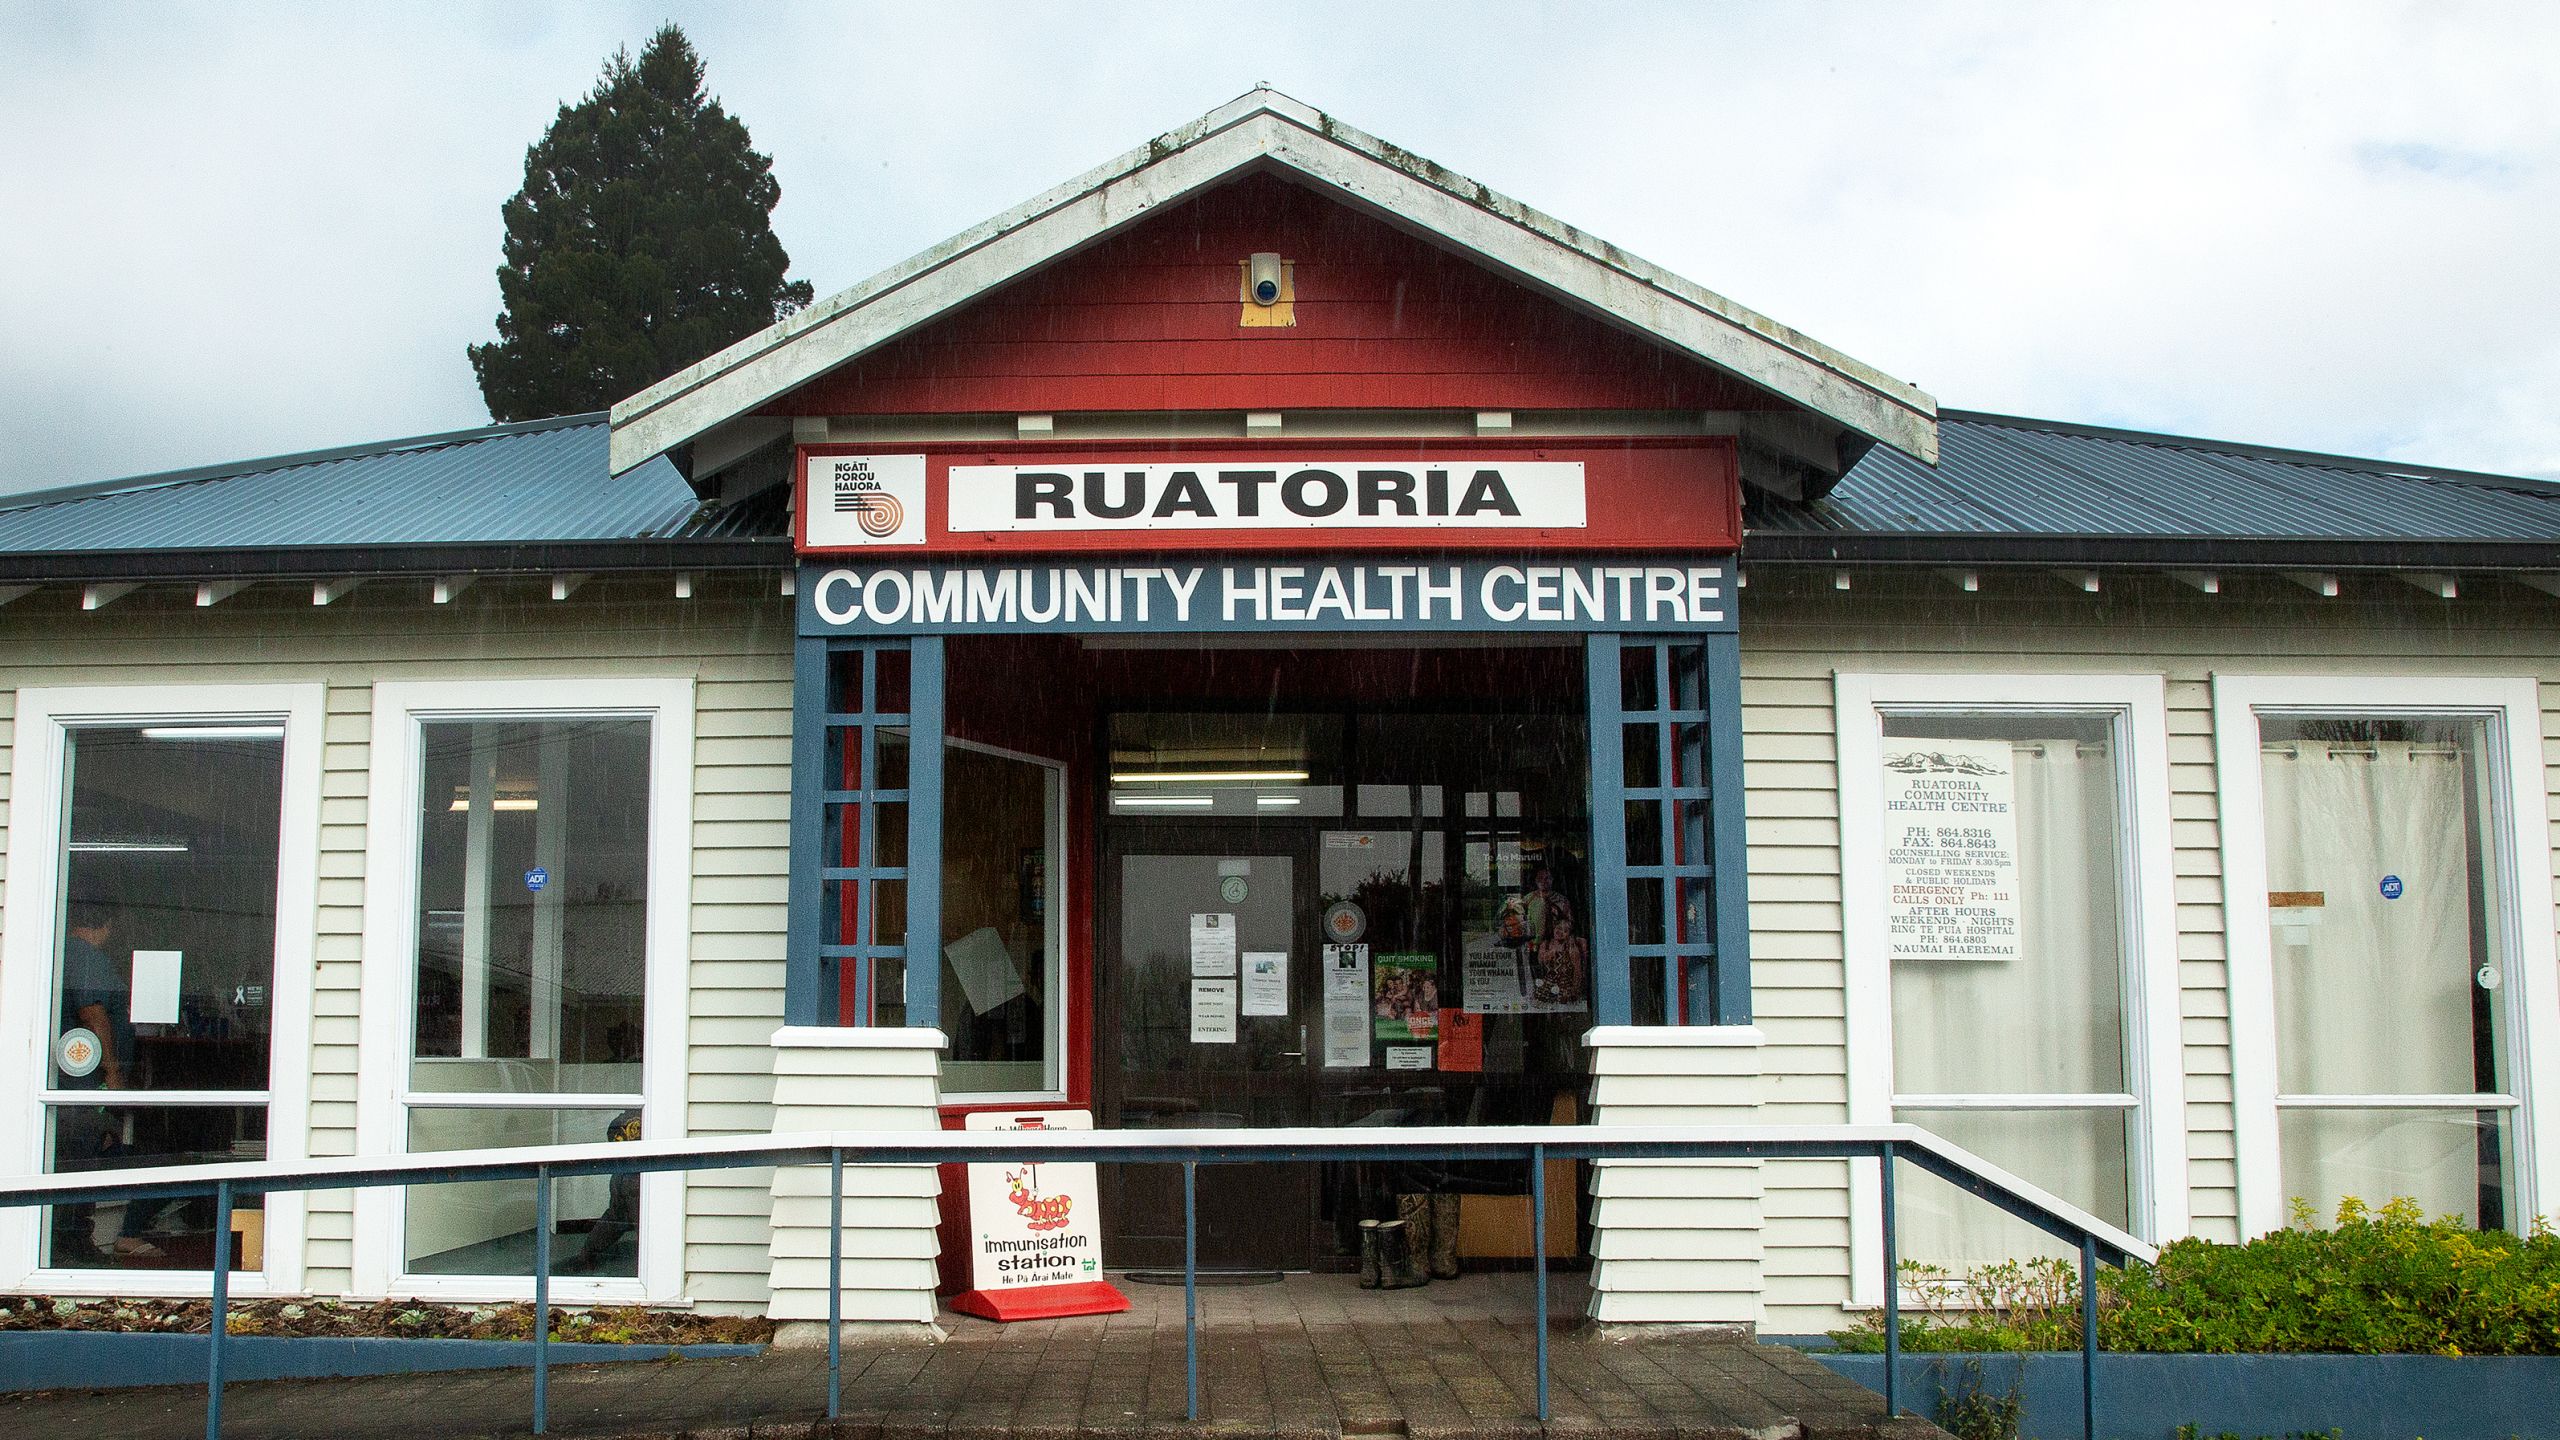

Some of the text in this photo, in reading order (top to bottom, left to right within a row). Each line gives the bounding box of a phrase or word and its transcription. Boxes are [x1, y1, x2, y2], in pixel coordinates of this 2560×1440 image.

[835, 461, 867, 472] NGĀTI
[835, 472, 874, 481] POROU
[835, 482, 881, 491] HAUORA
[1015, 469, 1521, 519] RUATORIA
[814, 566, 1723, 625] COMMUNITY HEALTH CENTRE
[1912, 779, 1981, 790] RUATORIA
[1904, 790, 1989, 801] COMMUNITY
[1887, 800, 2008, 813] HEALTH CENTRE
[1907, 827, 1992, 838] PH: 864.8316
[1903, 837, 1996, 849] FAX: 864.8643
[1889, 848, 1961, 857] COUNSELLING
[1888, 857, 1926, 865] MONDAY
[1929, 857, 1937, 865] to
[1940, 857, 1972, 866] FRIDAY
[1905, 868, 1996, 877] CLOSED WEEKENDS
[528, 875, 545, 884] ADT
[1916, 877, 1950, 885] PUBLIC
[1953, 878, 1997, 886] HOLIDAYS
[1893, 885, 1965, 895] EMERGENCY
[2383, 882, 2400, 892] ADT
[1893, 895, 1965, 905] CALLS ONLY
[1971, 891, 2009, 901] Ph: 111
[1909, 907, 1996, 916] AFTER HOURS
[1891, 916, 1957, 925] WEEKENDS
[1971, 917, 2015, 926] NIGHTS
[1891, 925, 2015, 935] RING TE PUIA HOSPITAL
[1920, 935, 1987, 944] PH: 864.6803
[1893, 944, 2014, 954] NAUMAI HAEREMAI
[1377, 955, 1434, 963] QUIT SMOKING
[983, 1232, 1087, 1253] immunisation
[998, 1251, 1076, 1271] station
[1002, 1275, 1014, 1284] He
[1051, 1271, 1073, 1281] Mate
